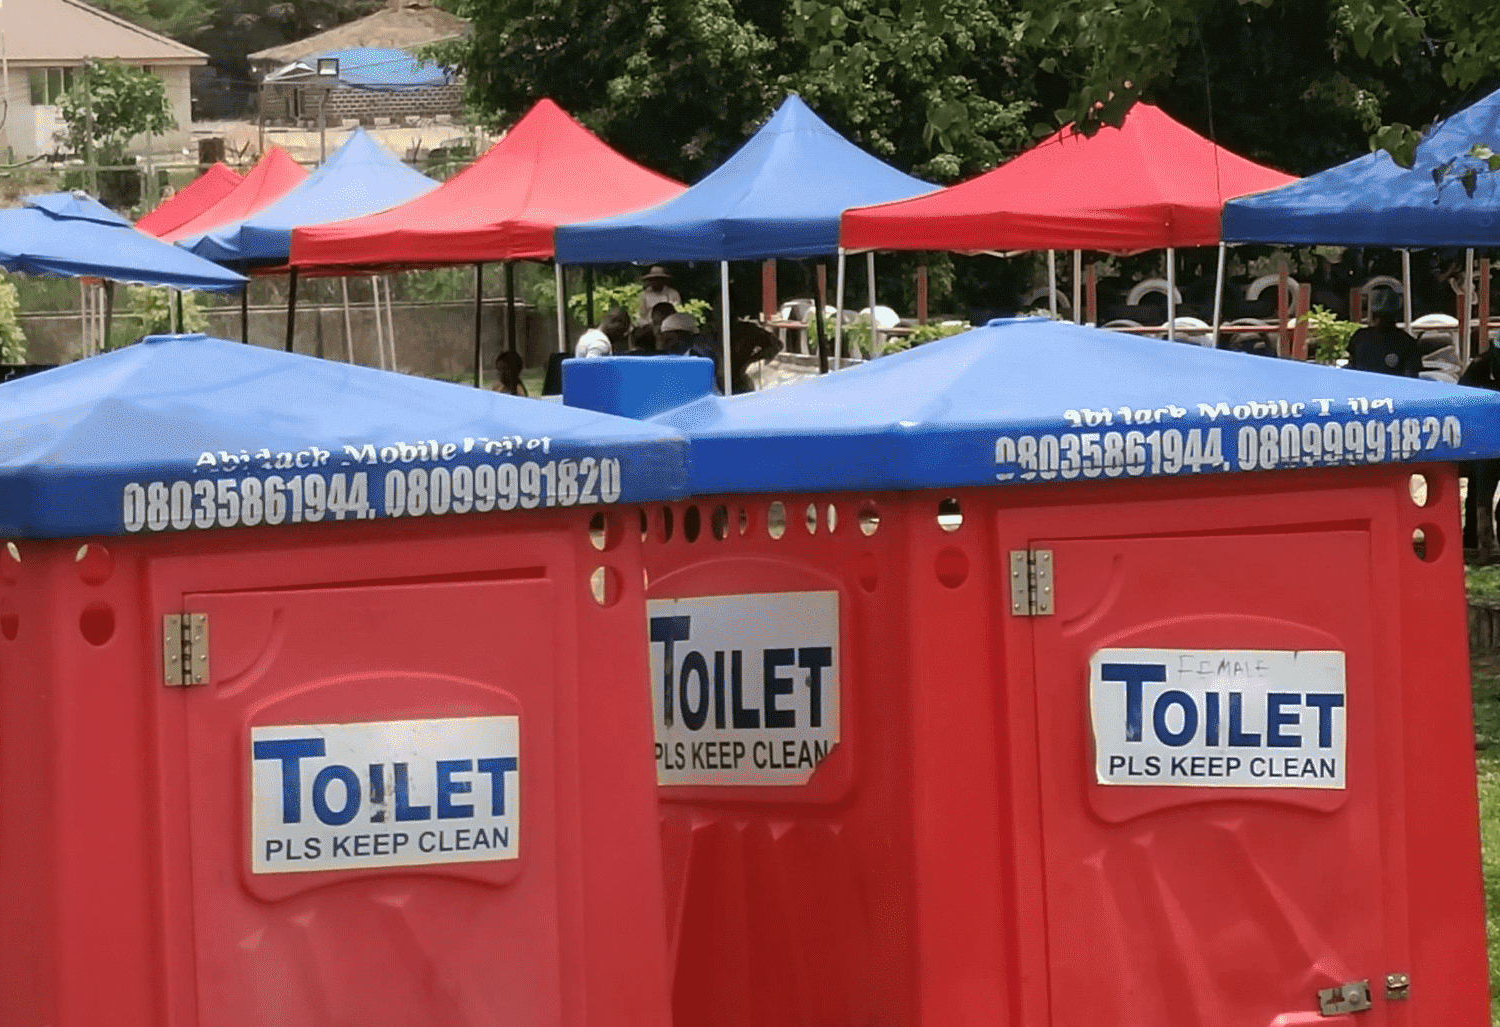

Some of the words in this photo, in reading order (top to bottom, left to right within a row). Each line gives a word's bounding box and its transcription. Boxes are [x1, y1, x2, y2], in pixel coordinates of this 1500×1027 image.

[341, 438, 456, 466] Mobile
[1238, 415, 1462, 471] 08099991820
[384, 456, 621, 518] 08099991820
[650, 615, 833, 731] TOILET
[1101, 663, 1344, 748] TOILET
[253, 737, 518, 826] TOILET
[692, 741, 746, 770] KEEP
[753, 740, 828, 770] CLEAN
[1109, 755, 1161, 776] PLS
[1170, 756, 1242, 777] KEEP
[1250, 757, 1336, 778] CLEAN
[265, 837, 322, 861] PLS
[332, 833, 410, 858] KEEP
[418, 826, 509, 853] CLEAN
